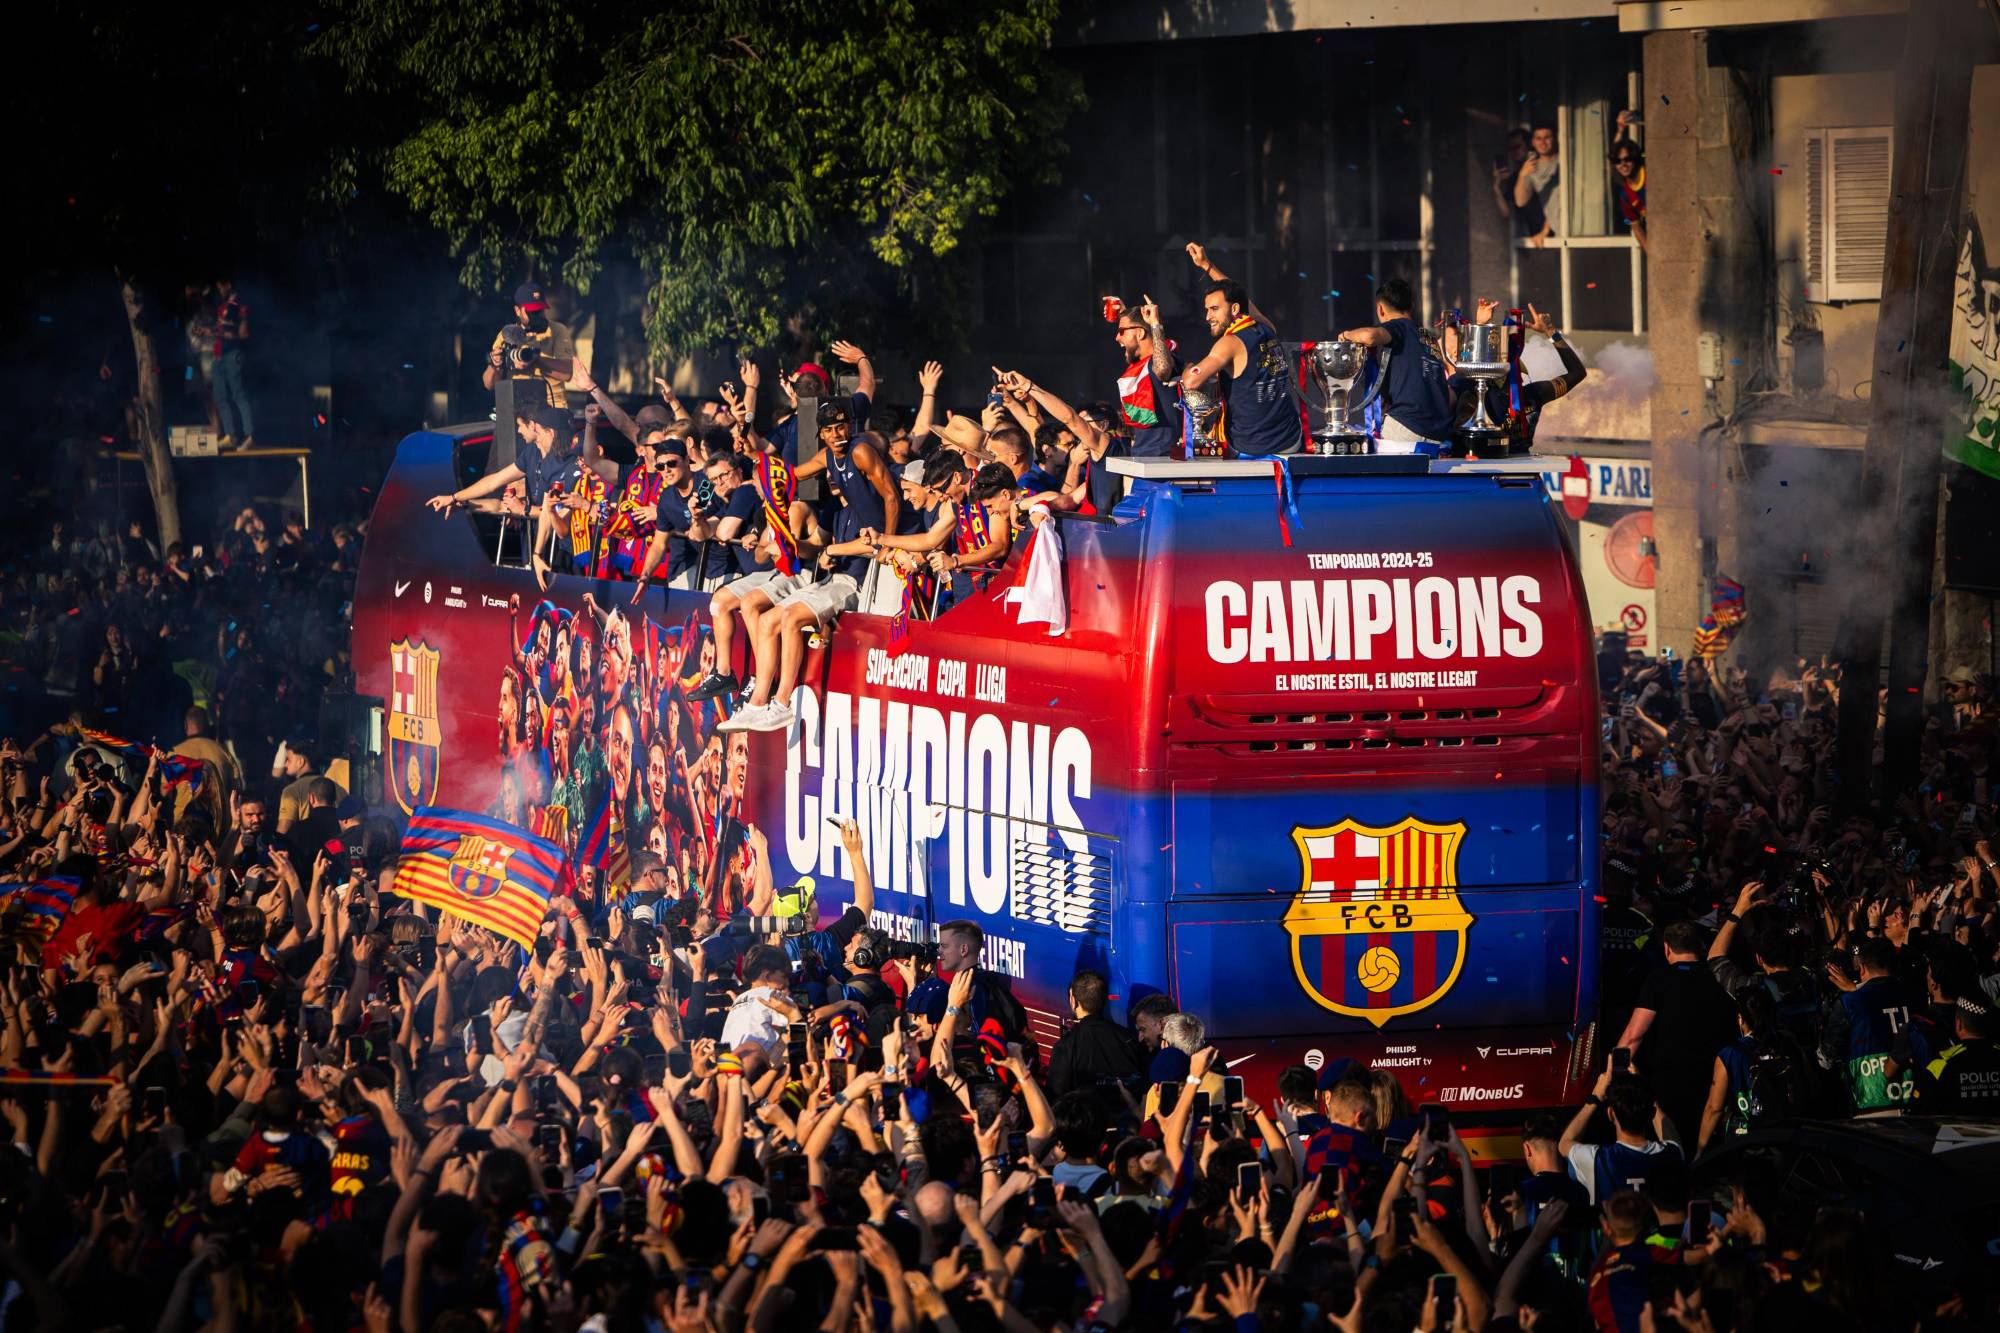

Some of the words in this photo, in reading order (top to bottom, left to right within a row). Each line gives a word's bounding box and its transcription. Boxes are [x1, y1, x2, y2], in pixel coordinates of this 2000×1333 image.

[1307, 553, 1380, 570] TEMPORADA
[1381, 551, 1433, 569] 2024-25
[1204, 575, 1543, 664] CAMPIONS
[866, 648, 929, 692] SUPERCOPA
[937, 659, 967, 698] COPA
[975, 664, 1007, 704] LLIGA
[1276, 676, 1289, 691] EL
[1291, 674, 1337, 690] NOSTRE
[1338, 673, 1374, 692] ESTIL,
[1375, 673, 1389, 689] EL
[1390, 672, 1436, 689] NOSTRE
[1437, 671, 1478, 688] LLEGAT
[403, 717, 424, 741] FCB
[785, 685, 1095, 933] CAMPIONS
[1341, 904, 1412, 930] FCB
[1385, 1046, 1417, 1054] PHILIPS
[1496, 1047, 1552, 1056] CUPRA
[1370, 1057, 1422, 1068] AMBILIGHT
[1423, 1058, 1432, 1066] tv
